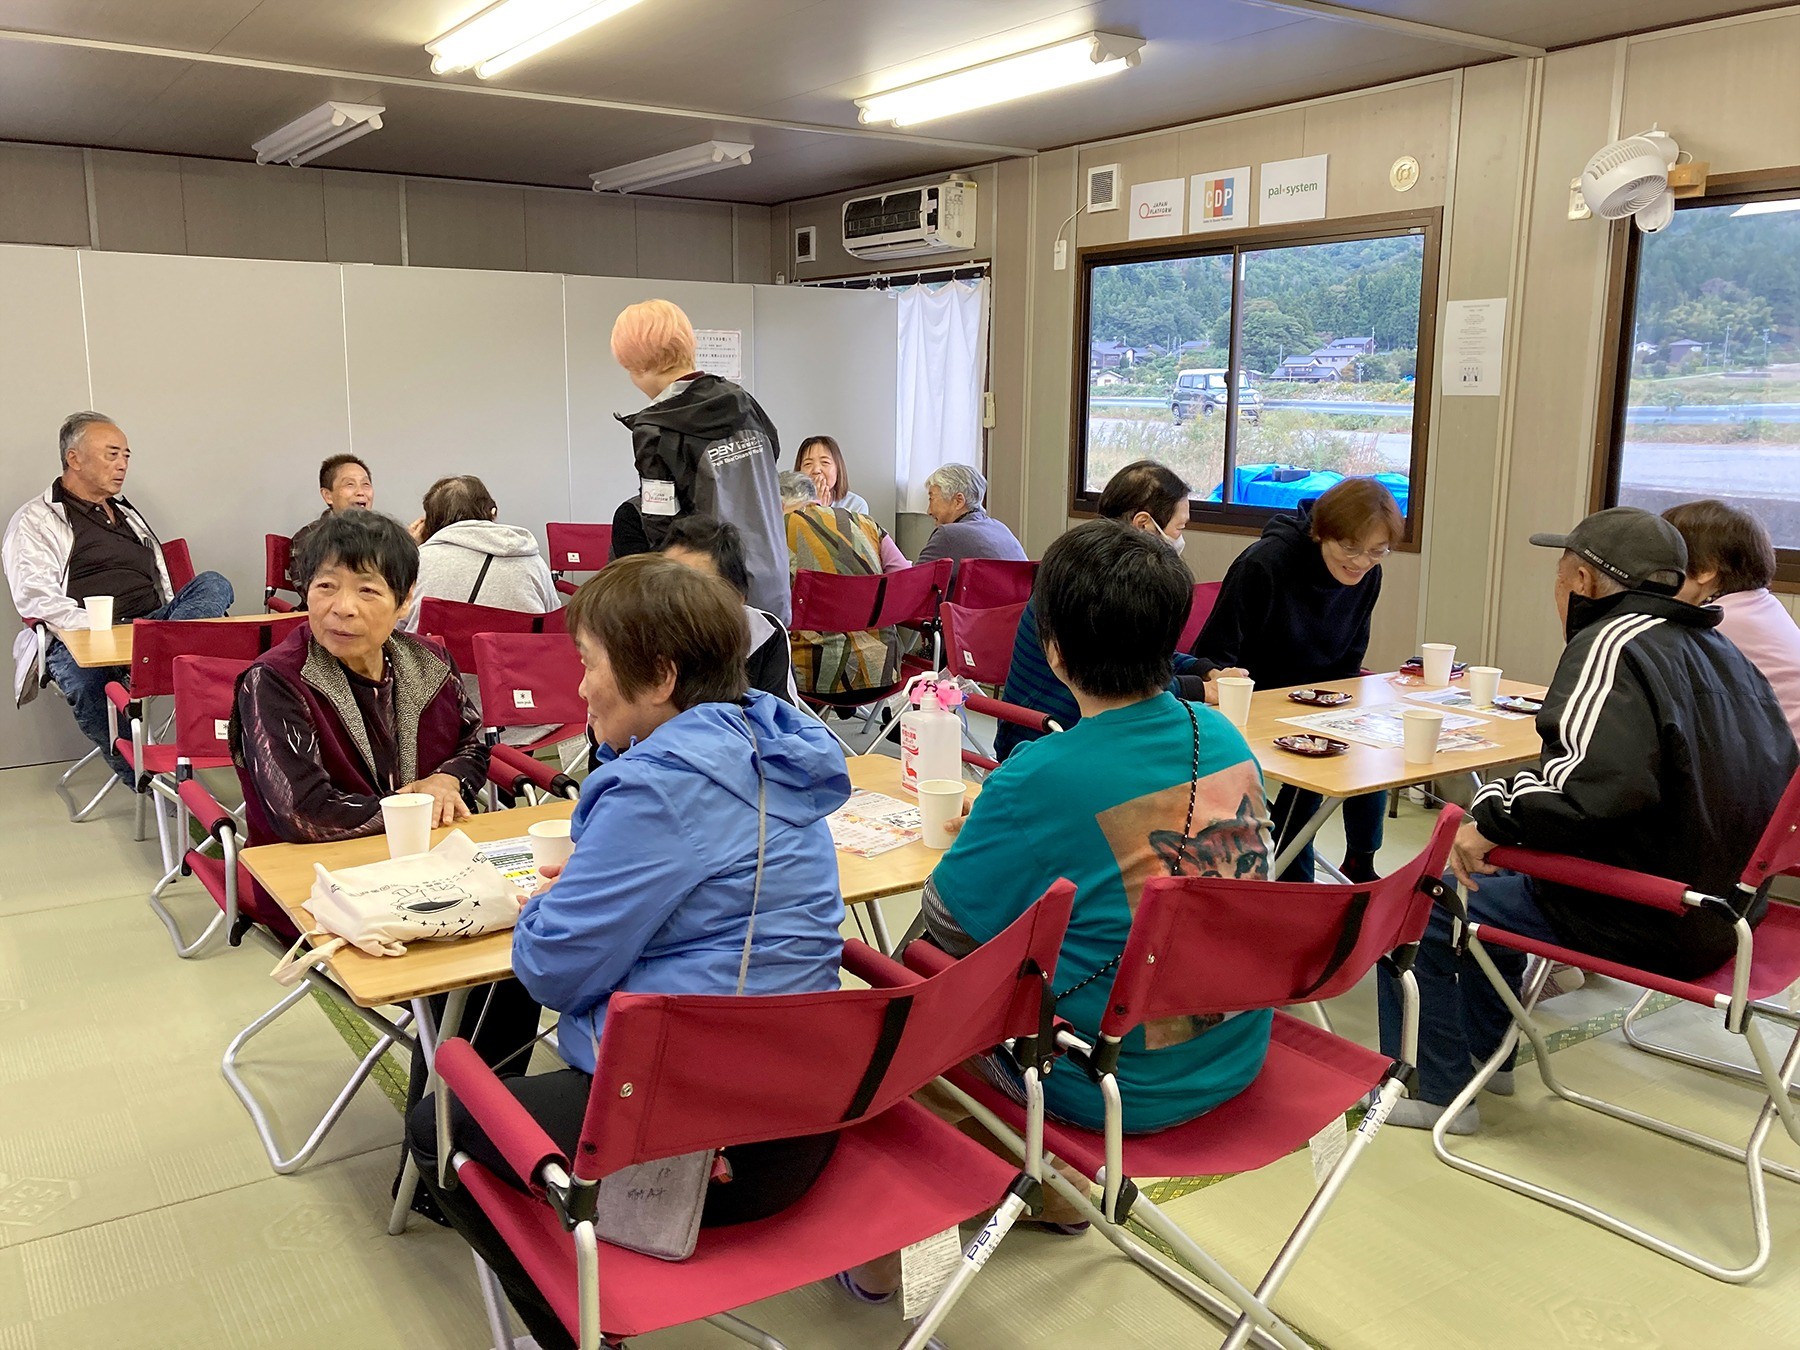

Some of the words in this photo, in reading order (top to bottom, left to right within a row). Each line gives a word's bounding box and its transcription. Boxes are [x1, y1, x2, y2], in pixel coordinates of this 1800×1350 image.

[1149, 207, 1172, 215] PLATFORM
[1205, 187, 1233, 209] CDP
[1358, 1095, 1382, 1133] PBV
[967, 1215, 998, 1261] PBV
